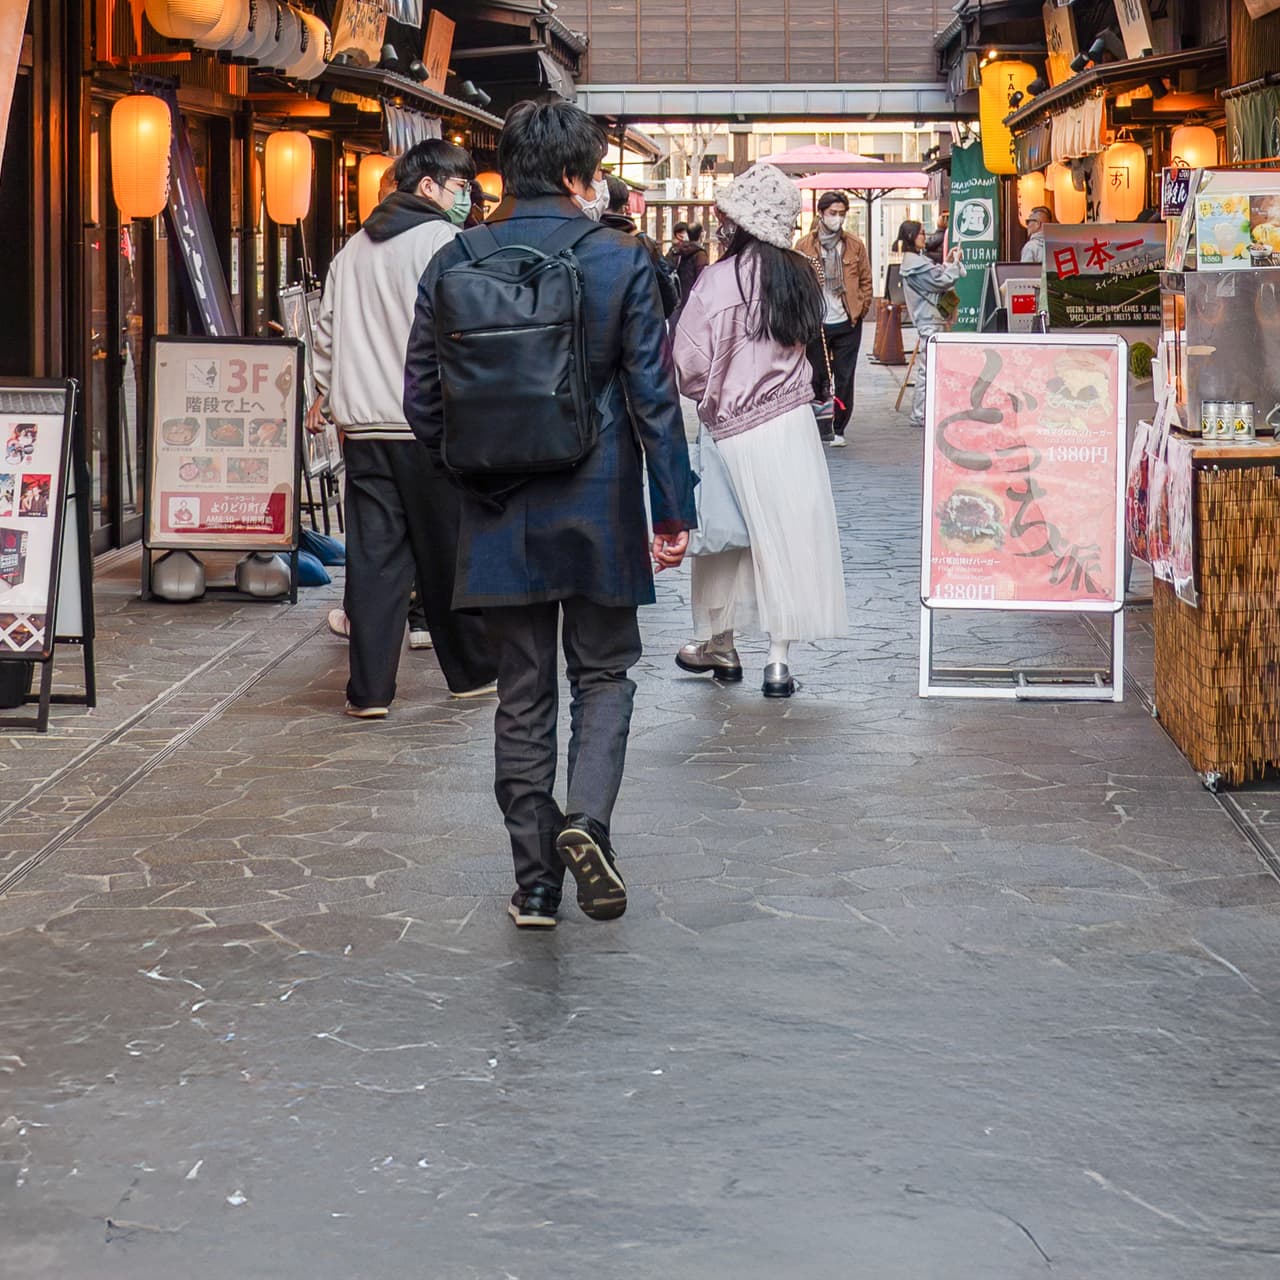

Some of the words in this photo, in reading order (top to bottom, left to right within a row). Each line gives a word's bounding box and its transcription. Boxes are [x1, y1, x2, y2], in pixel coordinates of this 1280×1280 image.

[1053, 238, 1144, 280] 日本一
[227, 359, 269, 394] 3F
[185, 397, 265, 413] 階段で上へ
[1046, 446, 1108, 464] 1380円
